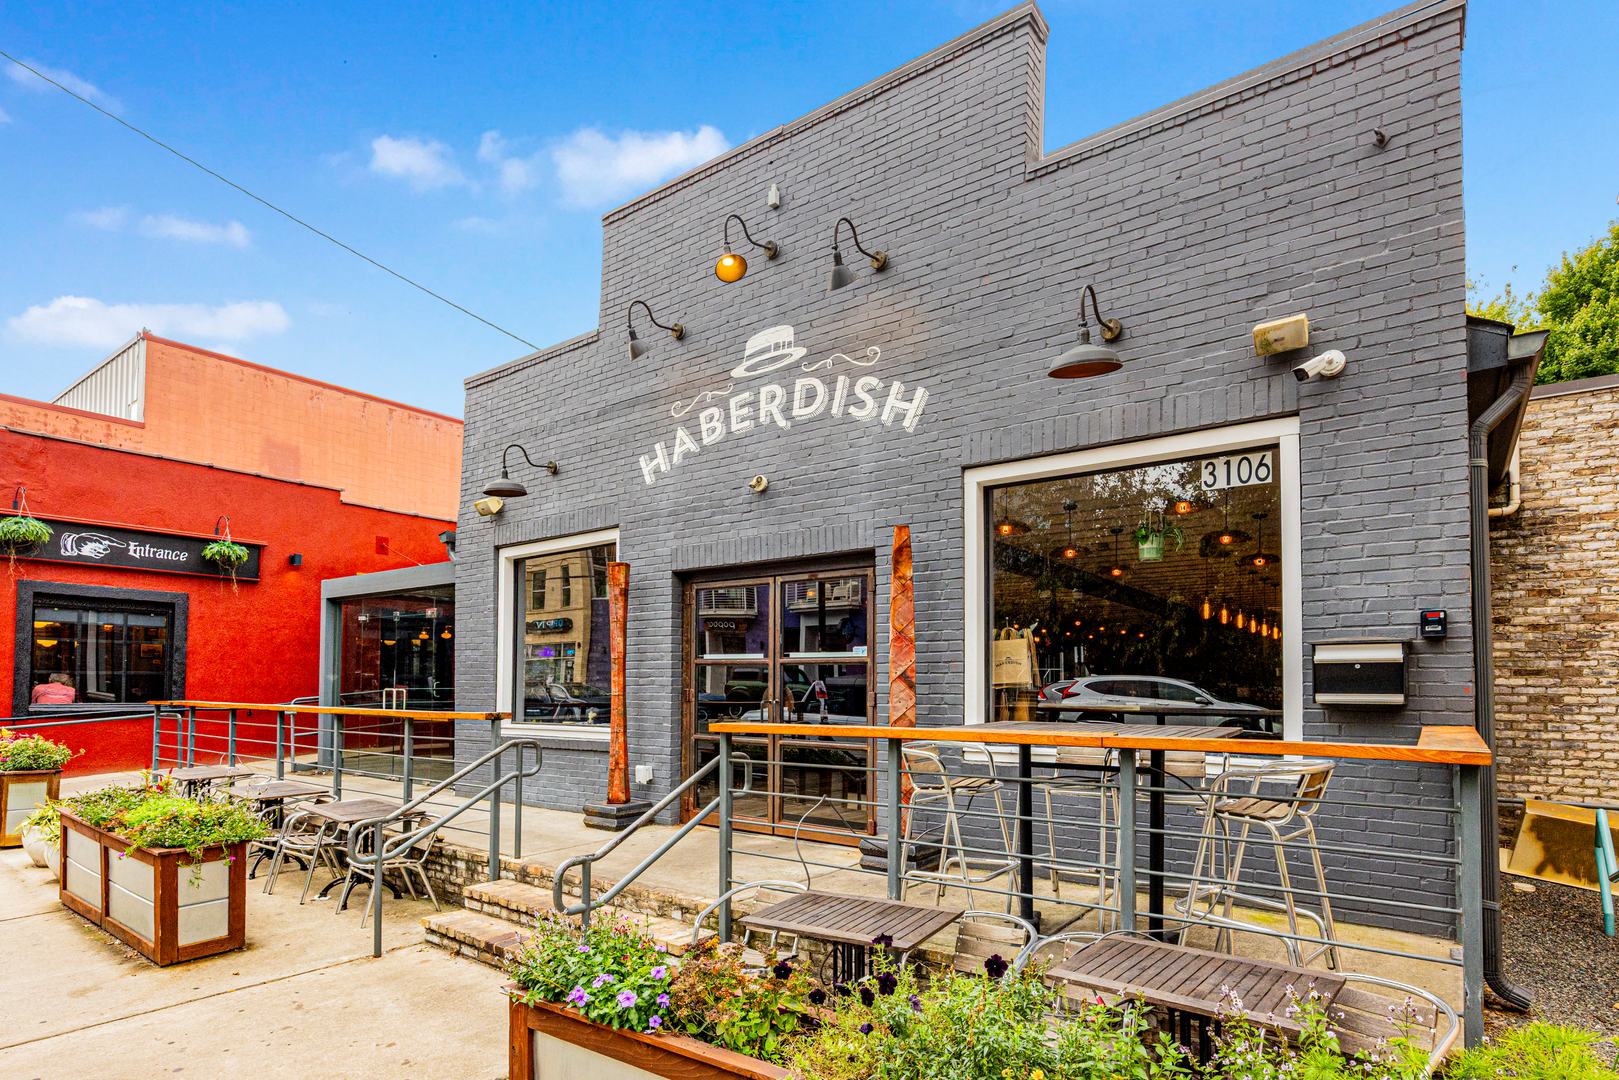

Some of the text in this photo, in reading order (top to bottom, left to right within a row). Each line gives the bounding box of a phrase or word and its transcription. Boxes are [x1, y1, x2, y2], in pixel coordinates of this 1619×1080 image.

[638, 375, 930, 485] HABERDISH
[1203, 454, 1270, 488] 3106
[128, 541, 189, 561] Entrance
